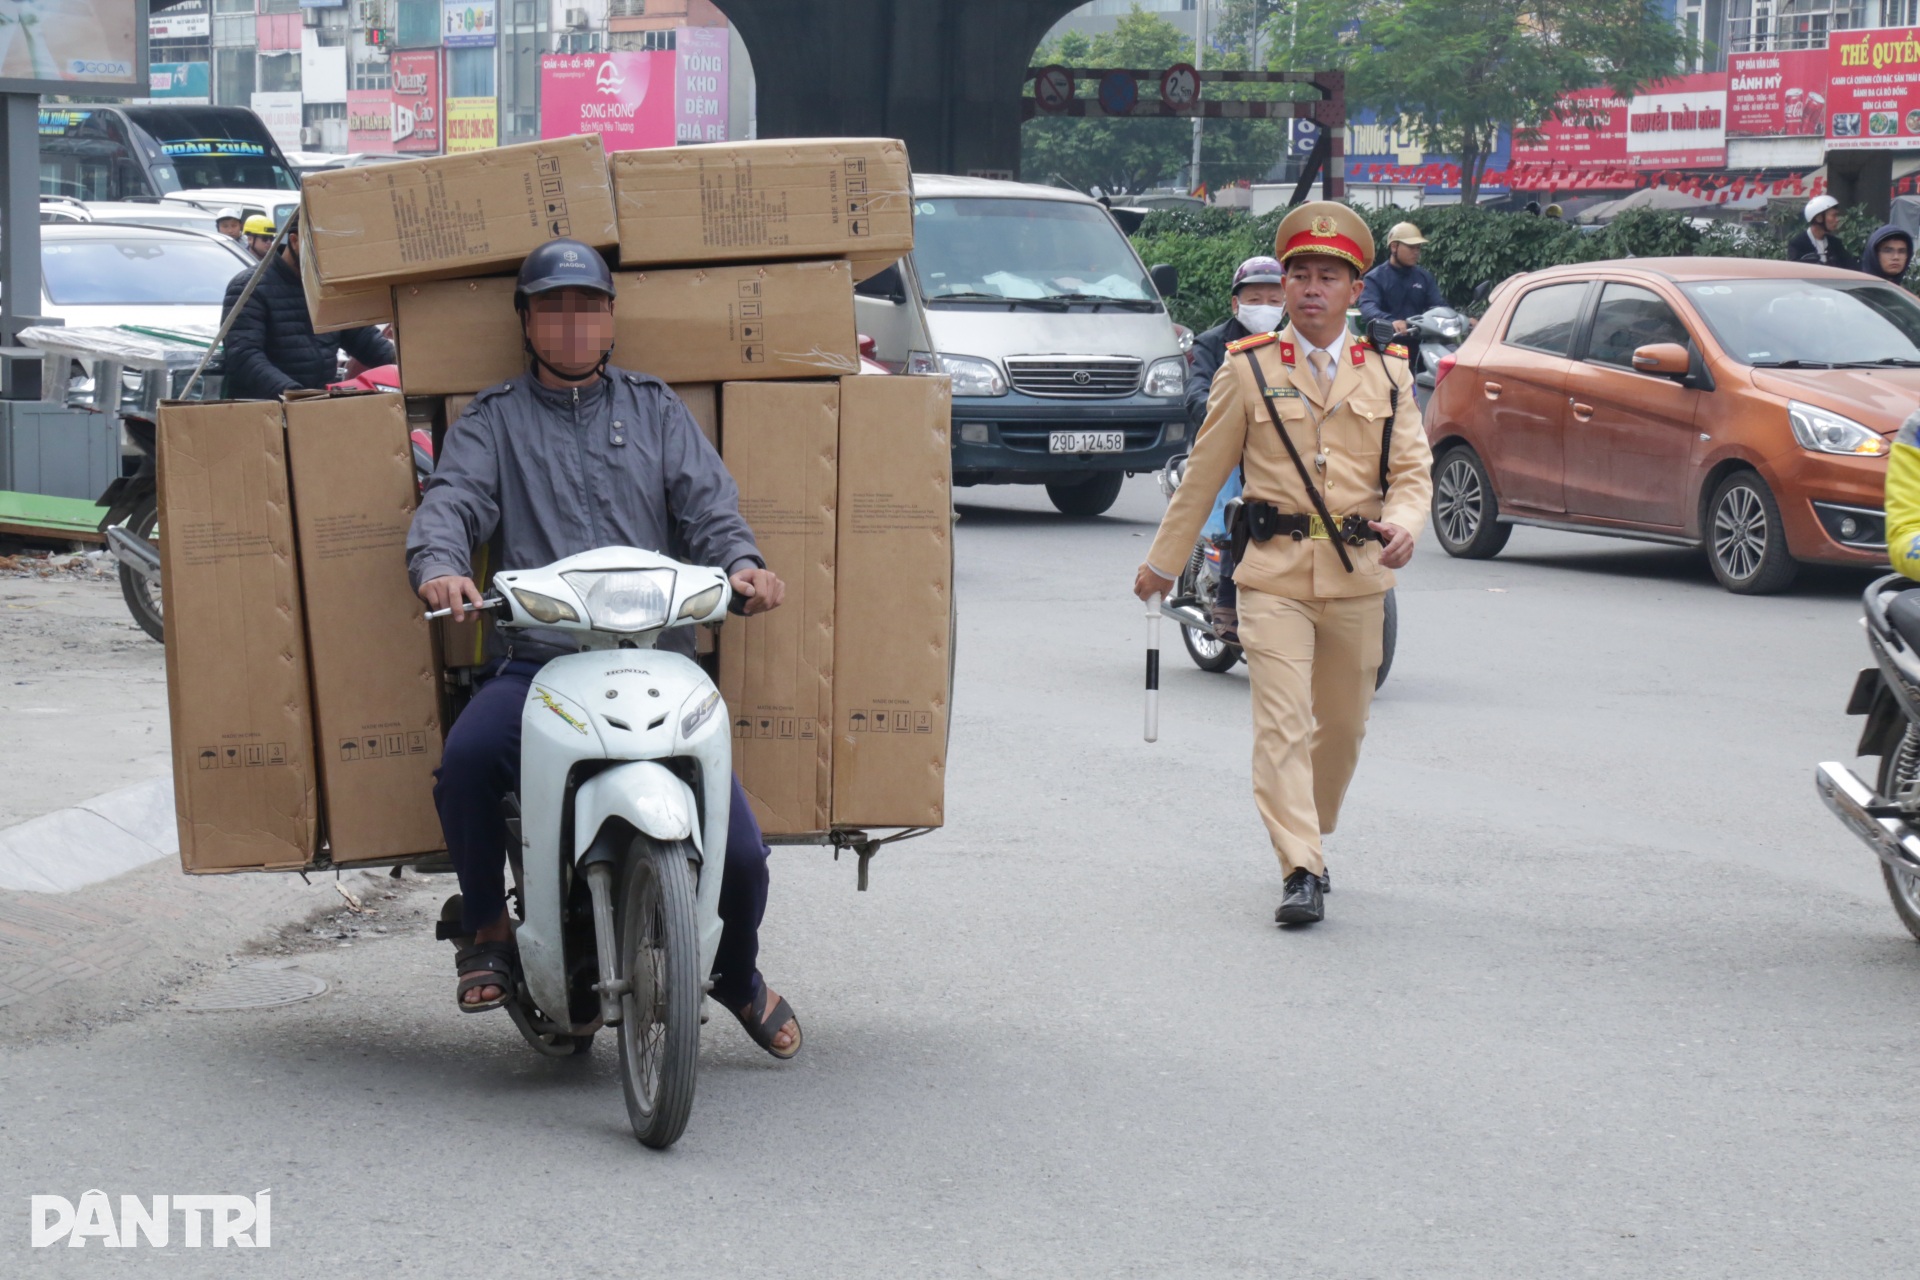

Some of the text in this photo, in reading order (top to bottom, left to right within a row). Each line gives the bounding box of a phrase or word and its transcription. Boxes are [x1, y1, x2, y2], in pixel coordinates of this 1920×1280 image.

[1840, 33, 1870, 66] THẾ
[682, 49, 722, 72] TỔNG
[687, 76, 717, 93] KHO
[1731, 74, 1763, 91] BÁNH
[581, 103, 634, 118] SONG HONG
[685, 98, 718, 118] ĐỆM
[391, 102, 414, 144] LED
[677, 121, 701, 140] GIÁ
[1052, 433, 1122, 451] 29D-124.58
[604, 668, 650, 677] HONDA
[804, 722, 811, 730] 3
[920, 715, 926, 724] 3
[414, 735, 420, 744] 3
[273, 746, 280, 756] 3
